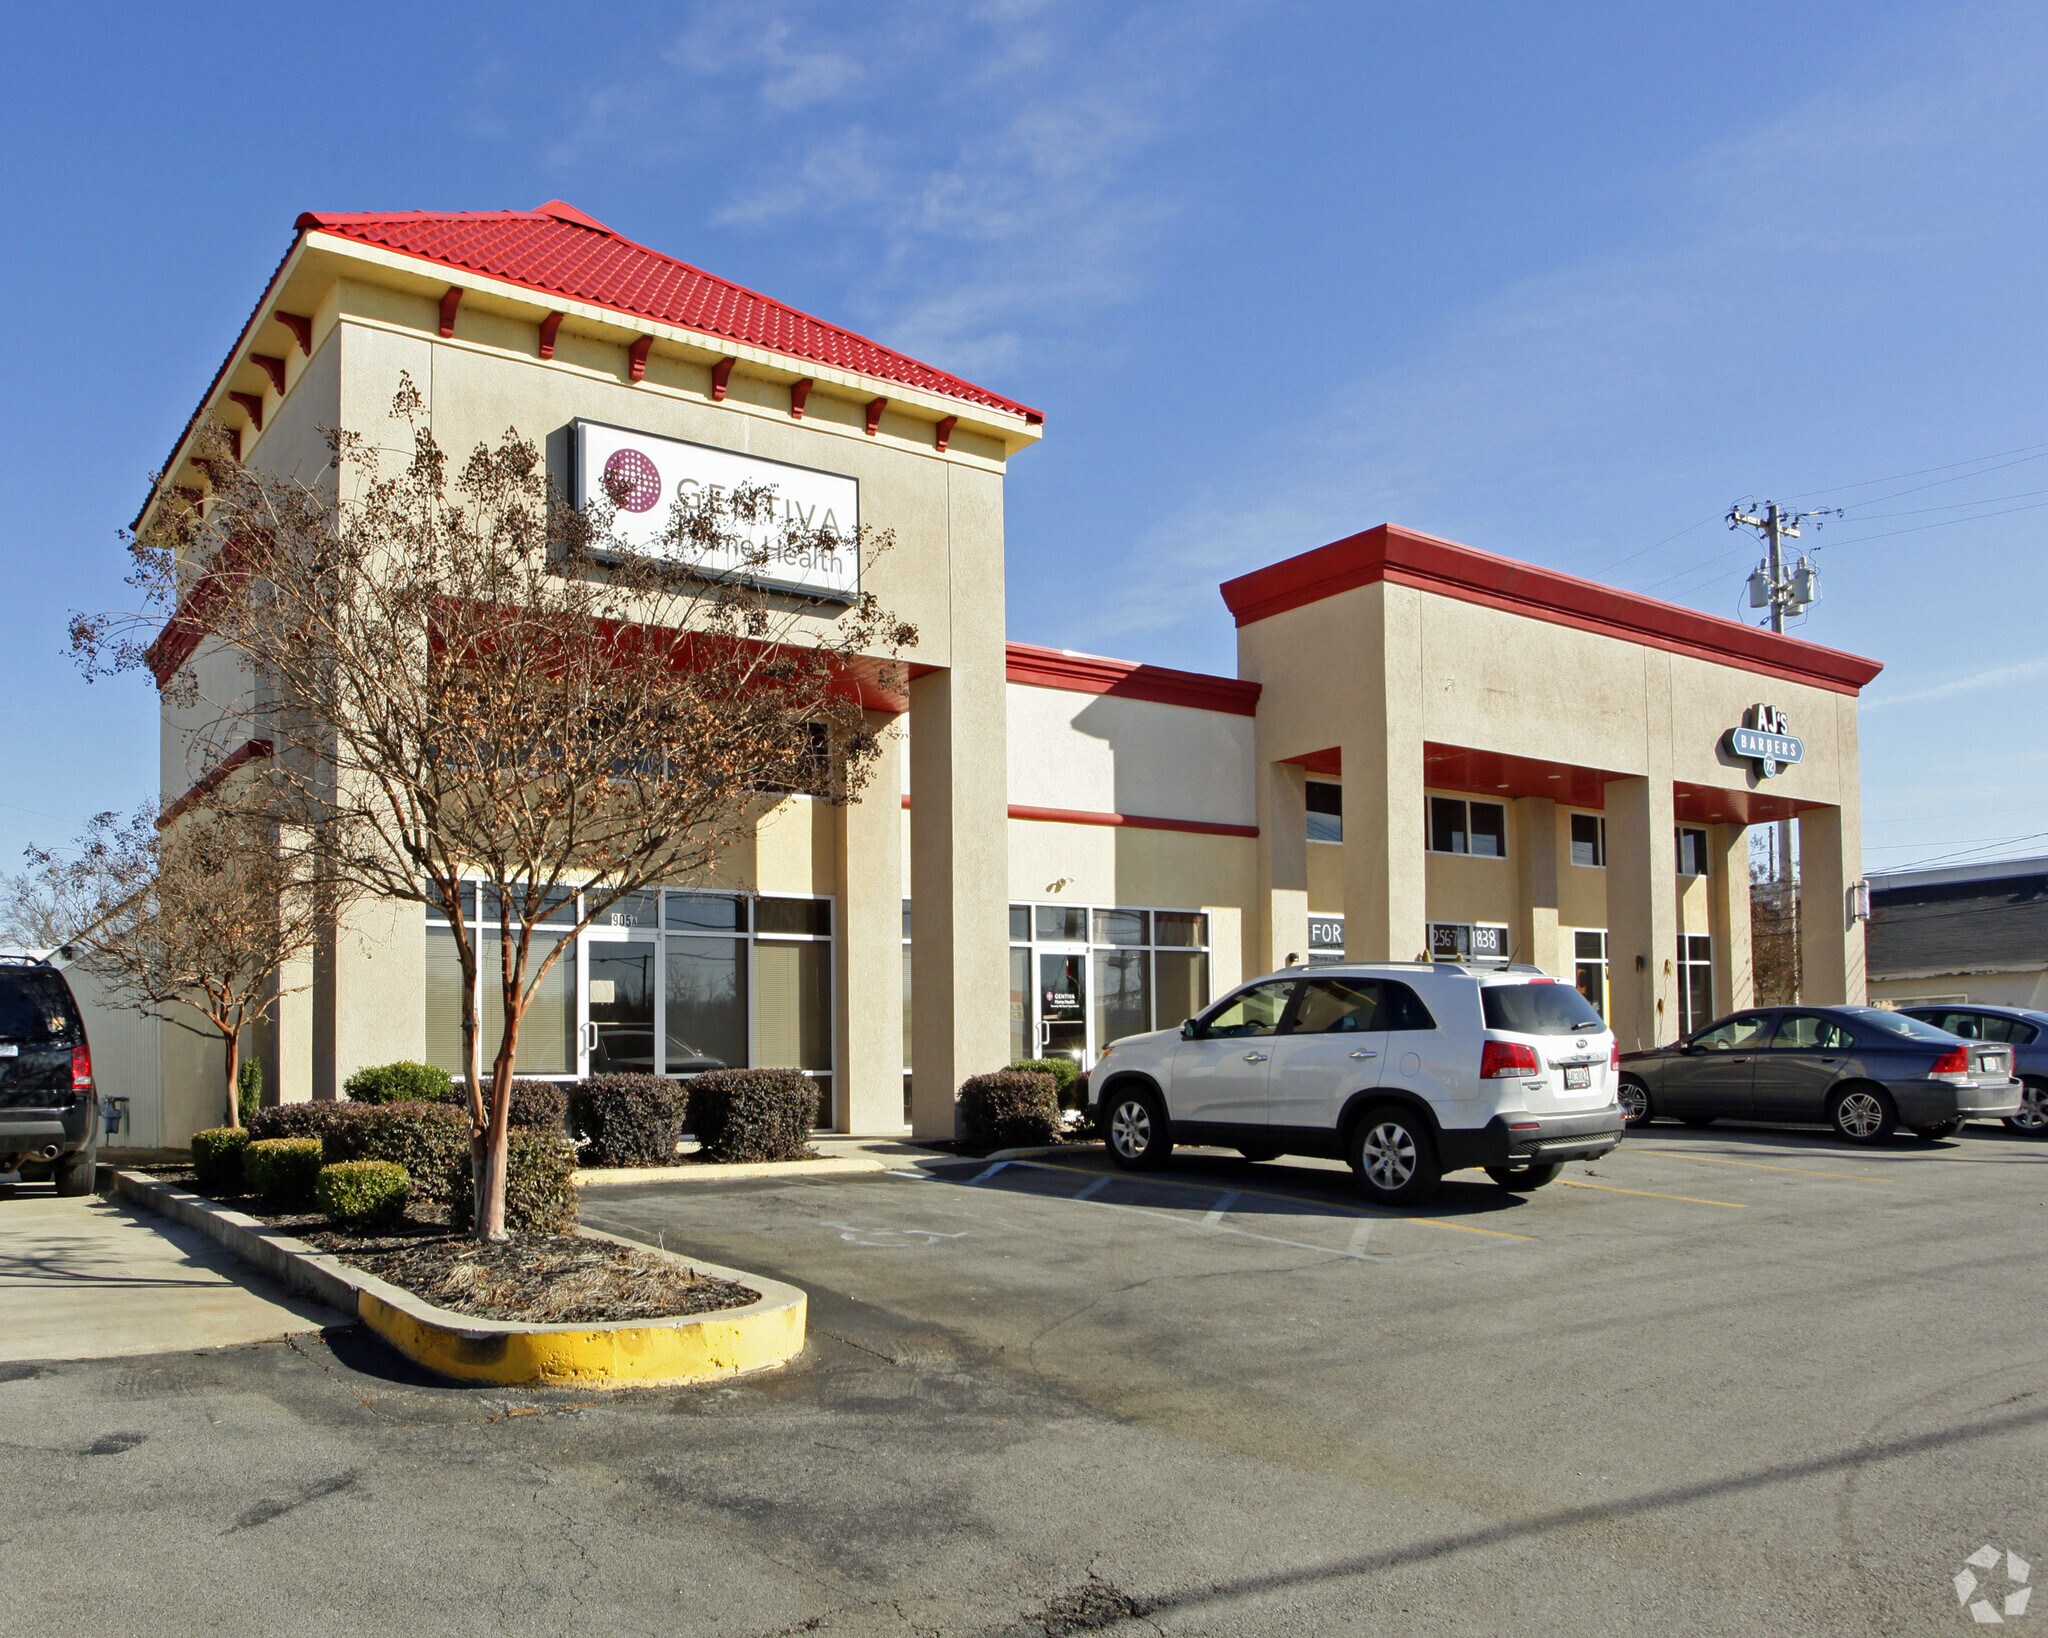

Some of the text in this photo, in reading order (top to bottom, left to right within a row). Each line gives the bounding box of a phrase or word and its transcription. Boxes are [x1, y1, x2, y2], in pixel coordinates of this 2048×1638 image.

[676, 478, 841, 538] GETIVA
[1740, 734, 1796, 757] BARBERS
[1766, 759, 1774, 772] 72
[1312, 923, 1342, 944] FOR
